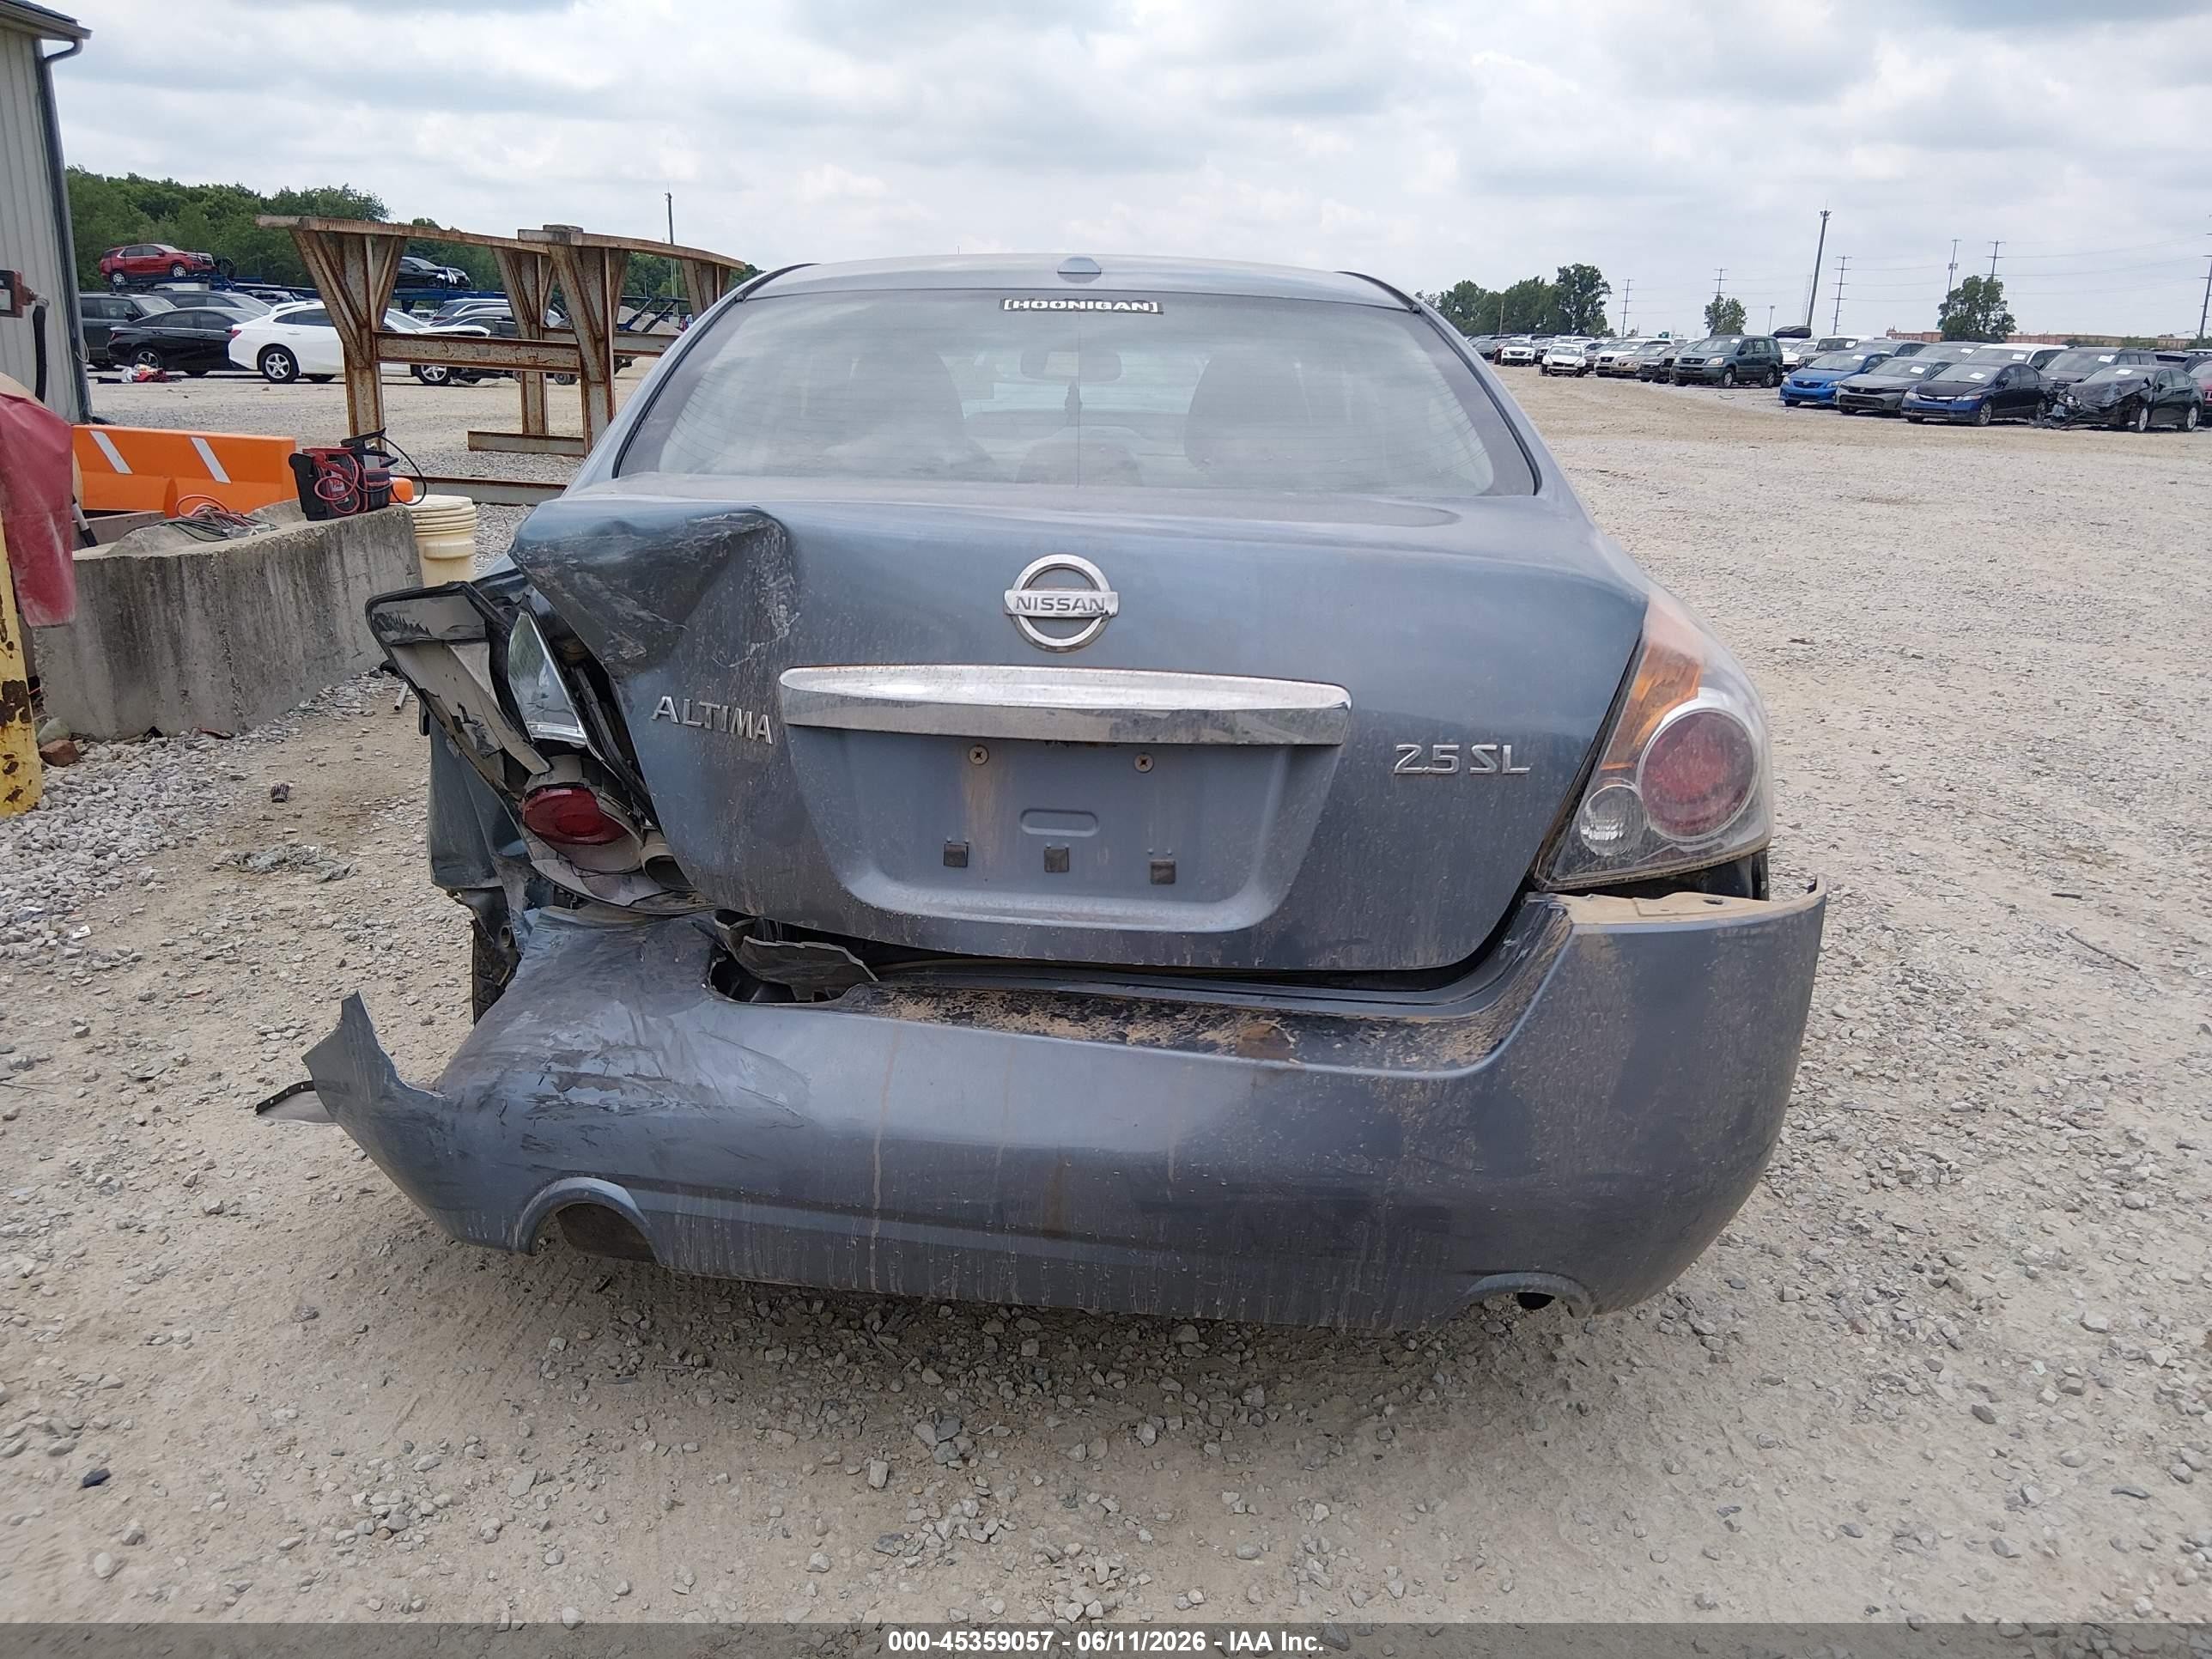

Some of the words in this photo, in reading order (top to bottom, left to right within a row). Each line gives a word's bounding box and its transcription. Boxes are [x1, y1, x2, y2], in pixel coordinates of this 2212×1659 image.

[1015, 595, 1106, 611] NISSAN
[651, 695, 774, 745] ALTIMA
[1394, 744, 1461, 775] 2.5
[1469, 744, 1531, 775] SL
